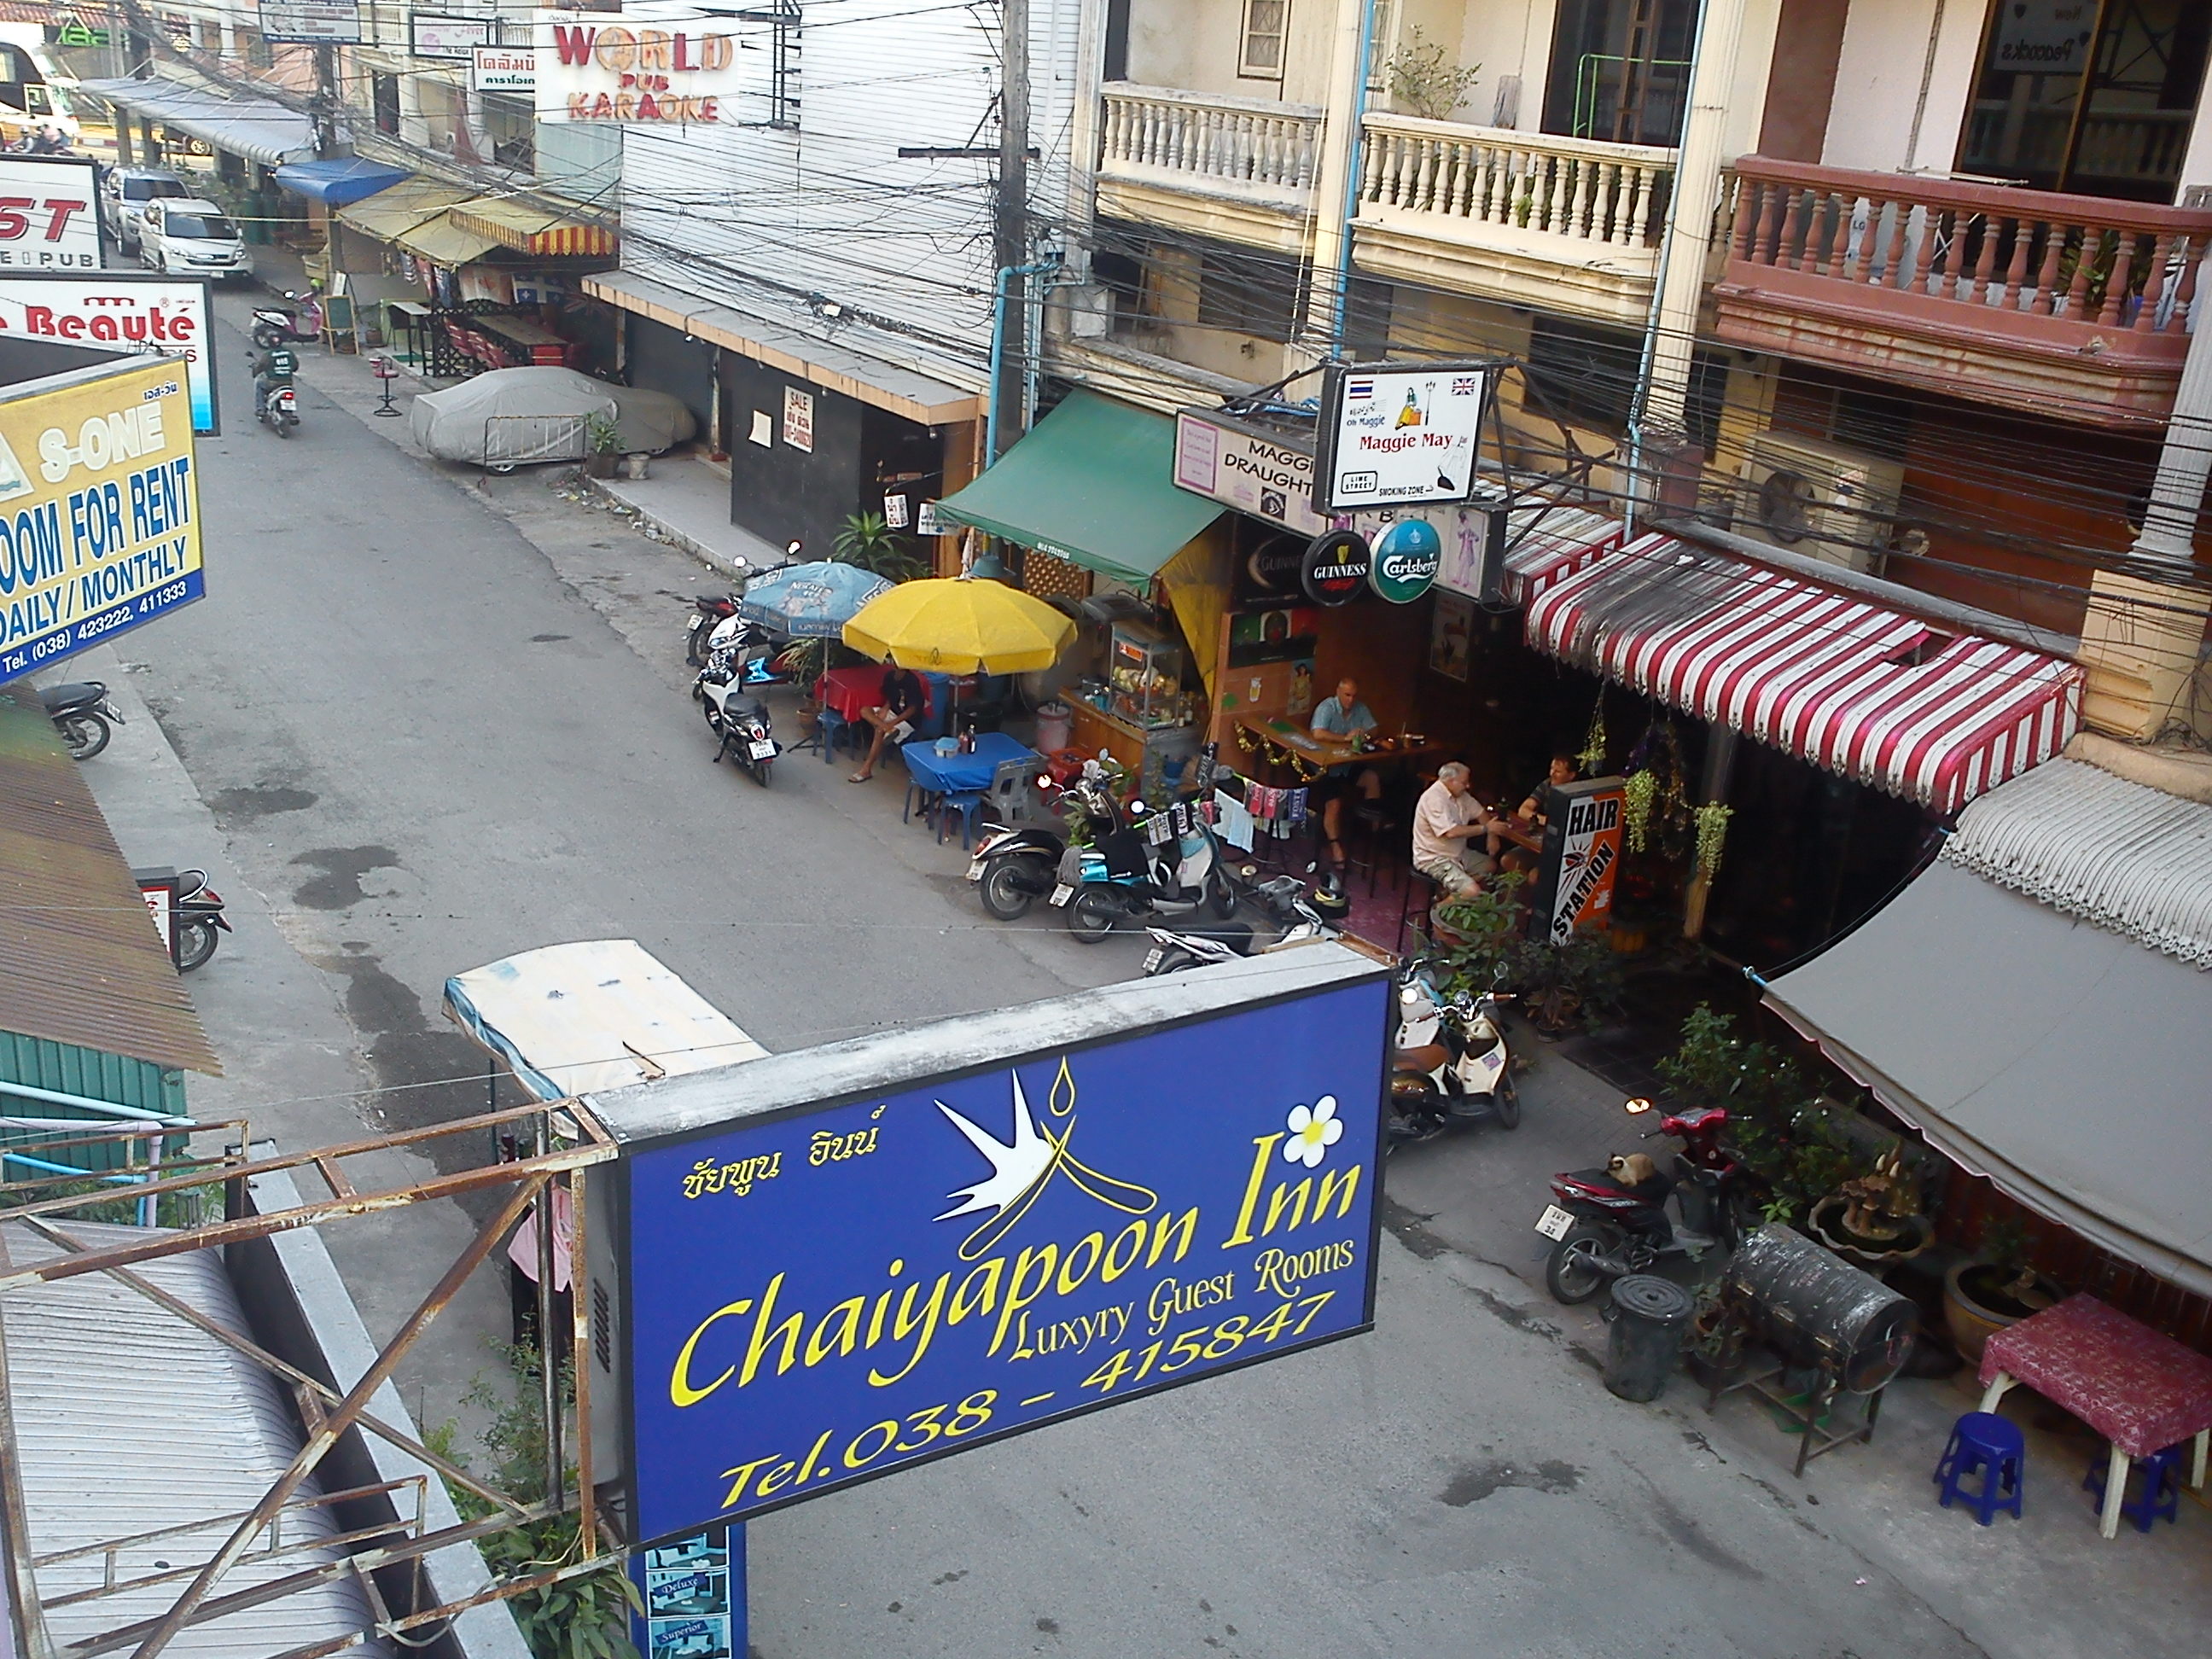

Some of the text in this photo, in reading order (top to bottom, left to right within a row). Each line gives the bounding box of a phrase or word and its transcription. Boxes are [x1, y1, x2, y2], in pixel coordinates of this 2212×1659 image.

[553, 26, 733, 72] WORLD
[620, 73, 669, 91] PUB
[568, 92, 719, 121] KARAOKE
[1853, 220, 1866, 230] LG
[39, 253, 93, 266] PUB
[26, 306, 195, 341] Beauté
[1359, 415, 1386, 428] Maggie
[38, 401, 166, 483] S-ONE
[1359, 433, 1452, 452] Maggie May
[1225, 453, 1313, 496] DRAUGHT
[1346, 481, 1372, 490] STREET
[1379, 486, 1424, 497] SMOKING ZONE
[68, 481, 125, 566] FOR
[130, 457, 189, 543] RENT
[81, 536, 186, 611] MONTHLY
[1313, 563, 1366, 579] GUINNESS
[1382, 553, 1439, 582] Carlsberg
[3, 581, 186, 672] Tel. (038) 423222, 411333
[1569, 800, 1619, 835] HAIR
[1553, 840, 1615, 937] STATION
[683, 1104, 886, 1199] ชัยพูน อินน์
[670, 1132, 1361, 1407] Chaiyapoon Inn
[1008, 1239, 1355, 1363] Luxyry Guest Rooms
[1080, 1290, 1336, 1393] 415847
[661, 1578, 698, 1593] Deluxe
[661, 1622, 701, 1643] Superior
